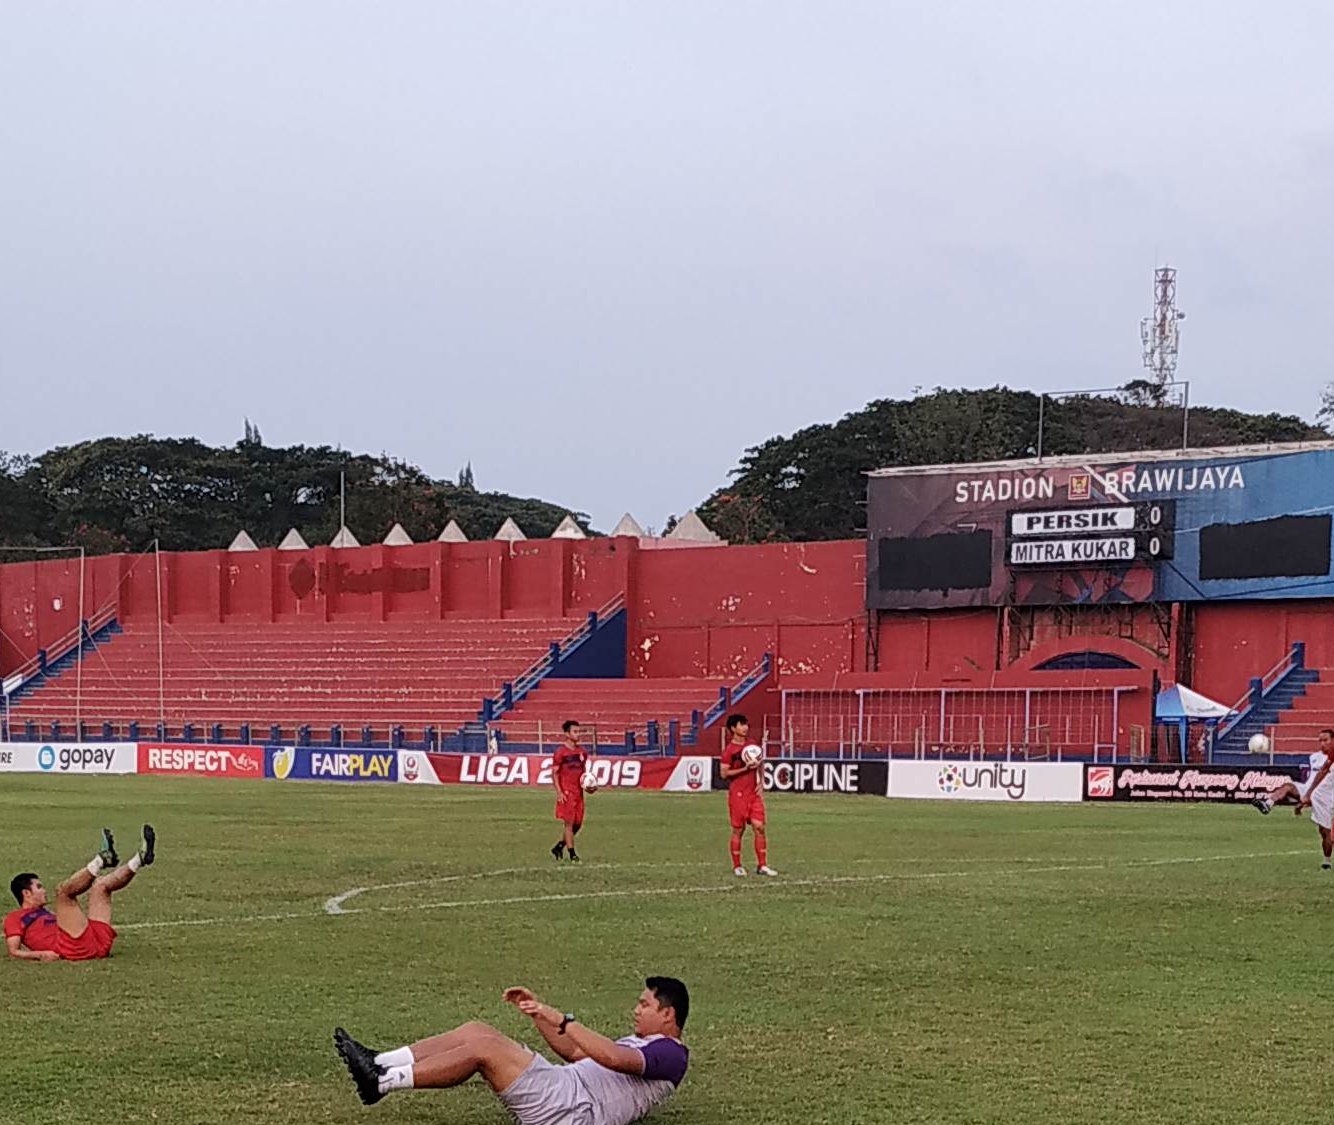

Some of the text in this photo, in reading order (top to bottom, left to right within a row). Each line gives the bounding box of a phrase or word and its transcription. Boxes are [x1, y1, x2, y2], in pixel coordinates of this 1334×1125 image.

[955, 465, 1245, 503] STADION BRAWIJAYA
[1026, 506, 1161, 531] PERSIK 0
[1015, 537, 1160, 561] MITRA KUKAR 0
[59, 748, 116, 770] gopay
[148, 749, 231, 772] RESPECT
[460, 755, 529, 785] LIGA
[762, 762, 859, 791] SCIPLINE
[963, 763, 1027, 799] unity
